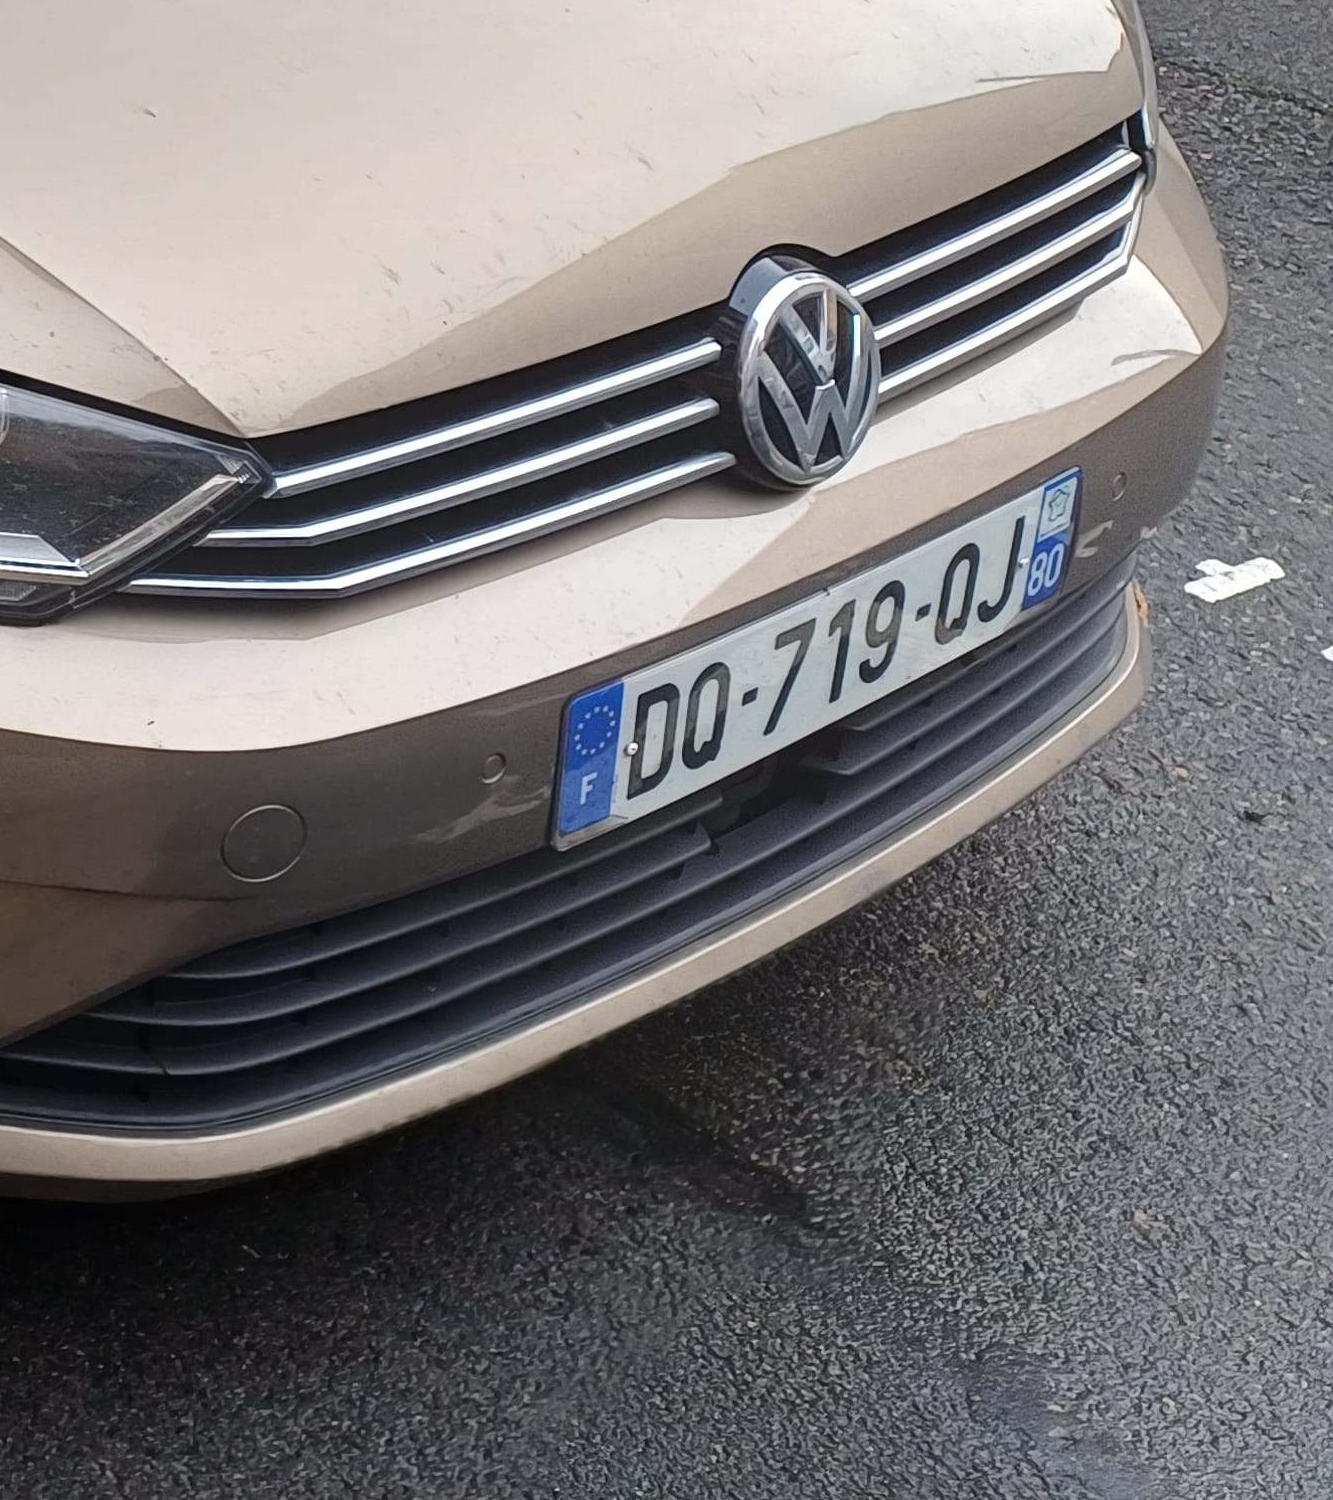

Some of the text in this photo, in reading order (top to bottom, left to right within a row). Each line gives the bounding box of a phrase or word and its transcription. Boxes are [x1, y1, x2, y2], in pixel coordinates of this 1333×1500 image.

[579, 516, 1065, 805] F DQ-719-QJ 80
